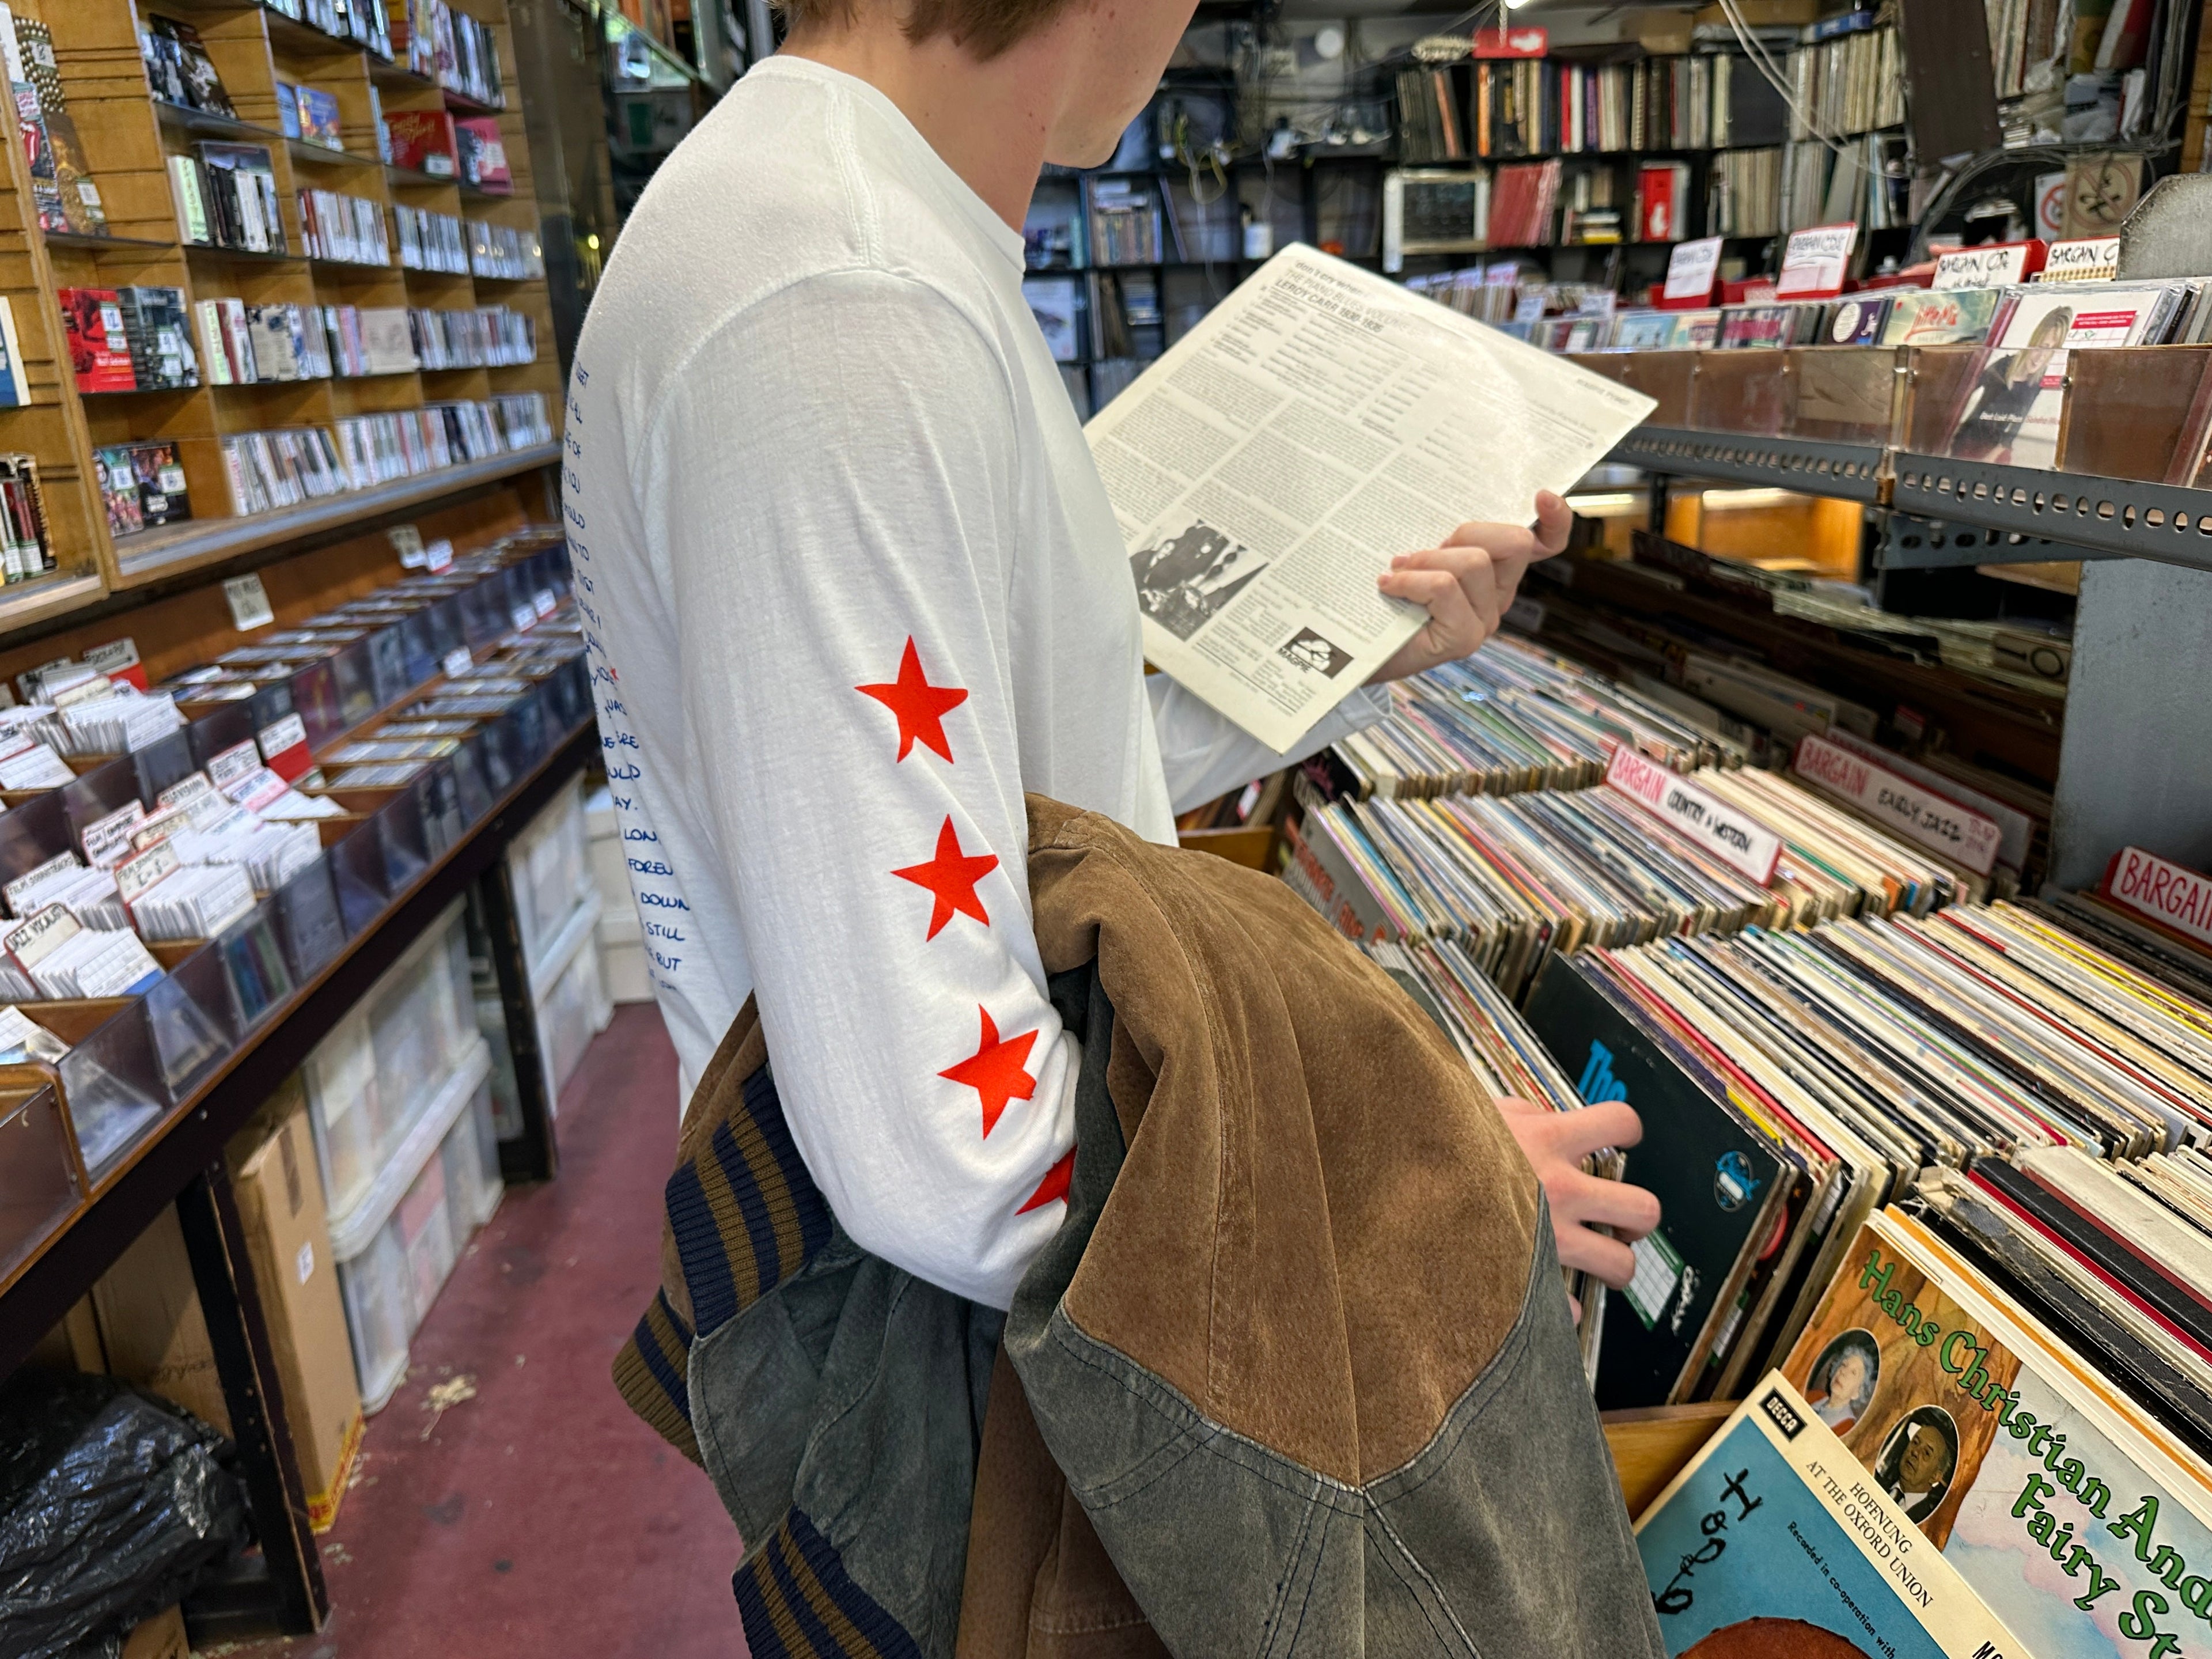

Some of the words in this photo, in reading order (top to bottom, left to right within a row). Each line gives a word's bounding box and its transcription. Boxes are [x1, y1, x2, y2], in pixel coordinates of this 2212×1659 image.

[2050, 243, 2099, 266] BARGAIN
[1275, 278, 1308, 298] LEROY
[1308, 291, 1338, 312] CARR
[1275, 646, 1311, 673] MAGPIE
[1613, 749, 1667, 805] BARGAIN
[1802, 741, 1869, 796] BARGAIN
[1878, 787, 1920, 824] EARLY
[641, 892, 690, 911] DOWN
[646, 922, 685, 941] STILL
[656, 952, 681, 971] BUT
[1766, 1396, 1799, 1433] DECCA
[1858, 1249, 1940, 1346] Hans
[1940, 1330, 2111, 1520] Christian
[2106, 1496, 2212, 1630] And
[1806, 1461, 1825, 1480] AT
[1822, 1476, 1847, 1506] THE
[1844, 1503, 1891, 1558] OXFORD
[1889, 1557, 1934, 1609] UNION
[1849, 1482, 1912, 1555] HOFFNUNG
[2010, 1473, 2120, 1611] Fairy
[2118, 1590, 2184, 1659] St
[1787, 1521, 1824, 1566] Recorded
[1820, 1563, 1830, 1577] in
[1830, 1576, 1876, 1637] co-operation
[1876, 1635, 1896, 1659] with
